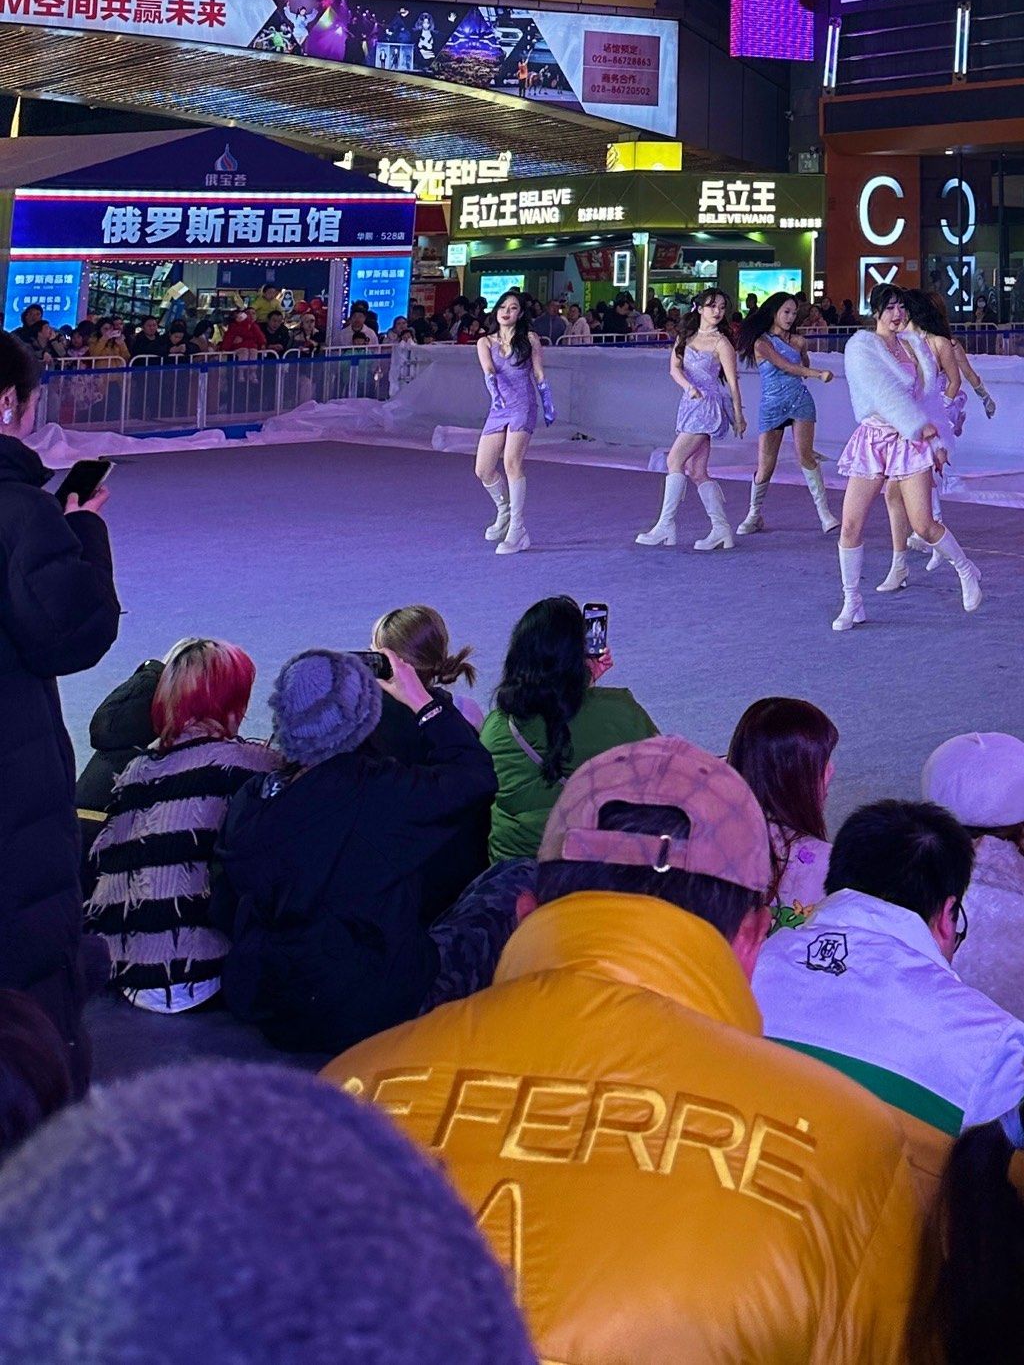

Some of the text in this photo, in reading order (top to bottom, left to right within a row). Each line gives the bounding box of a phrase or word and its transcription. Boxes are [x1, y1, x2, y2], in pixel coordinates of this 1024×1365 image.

[460, 193, 518, 229] 兵立王
[699, 180, 776, 212] 兵立王
[102, 206, 342, 244] 俄罗斯商品馆
[519, 207, 560, 225] WANG
